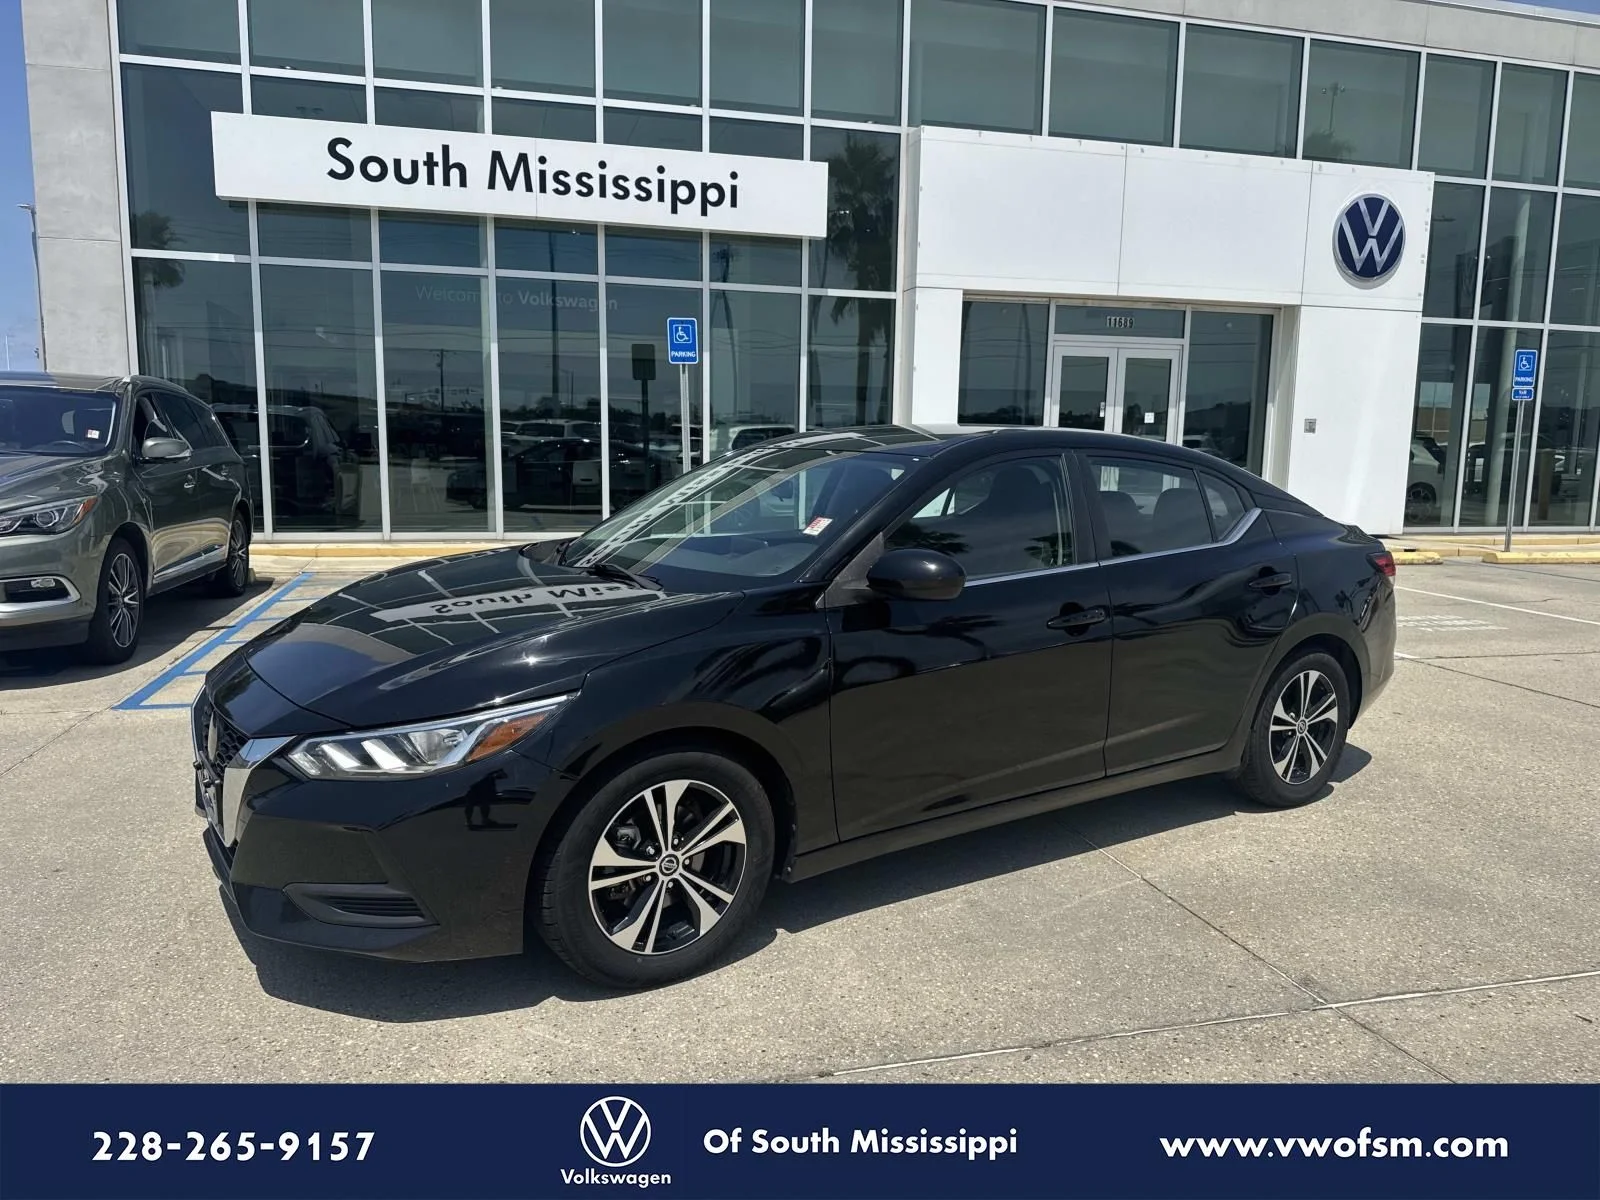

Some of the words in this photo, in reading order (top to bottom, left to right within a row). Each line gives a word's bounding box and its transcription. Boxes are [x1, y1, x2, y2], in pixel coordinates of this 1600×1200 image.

[327, 137, 467, 188] South
[487, 150, 739, 217] Mississippi
[517, 290, 618, 311] Volkswagn
[1107, 316, 1134, 329] 11689
